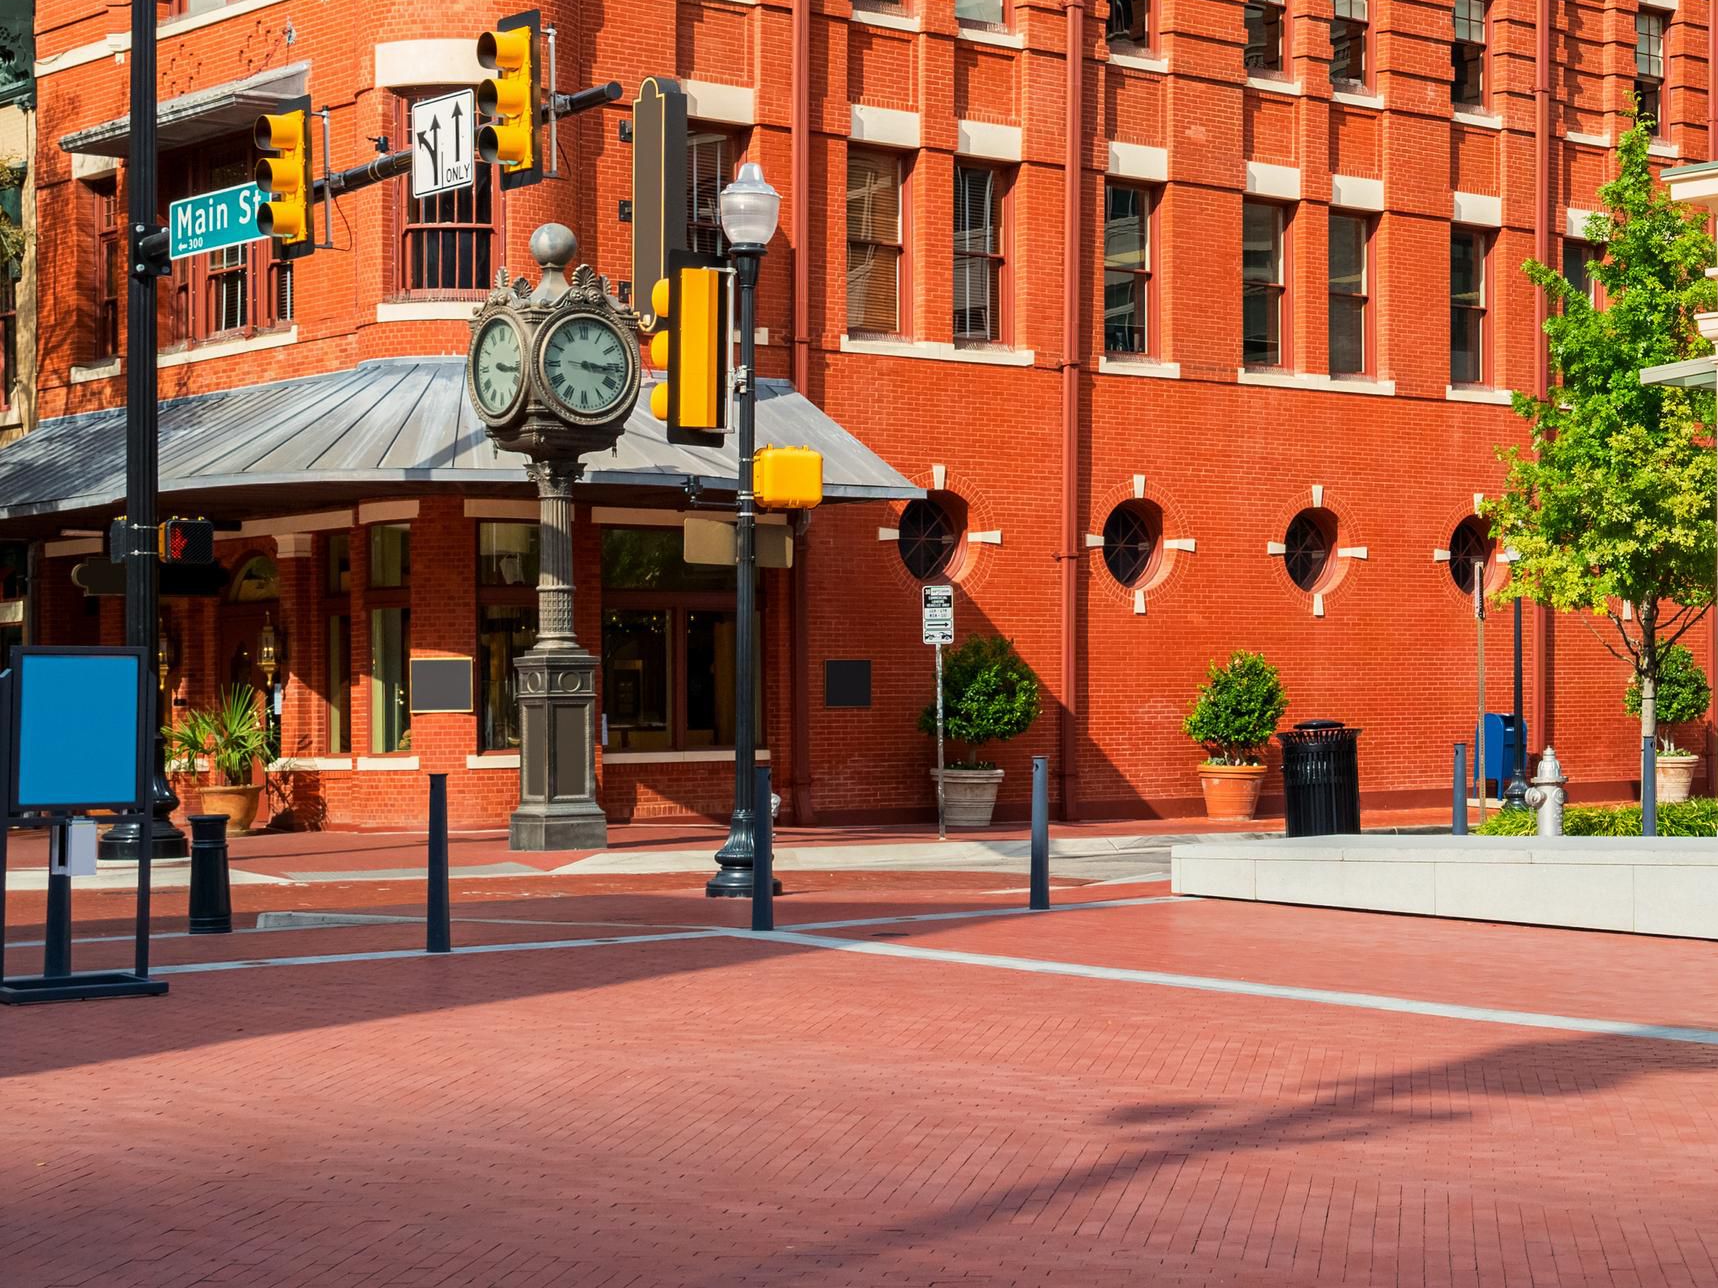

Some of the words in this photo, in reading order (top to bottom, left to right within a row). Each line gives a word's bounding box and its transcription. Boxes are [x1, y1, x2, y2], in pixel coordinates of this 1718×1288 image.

[446, 163, 470, 183] ONLY
[177, 198, 228, 239] Main
[188, 237, 204, 250] 300
